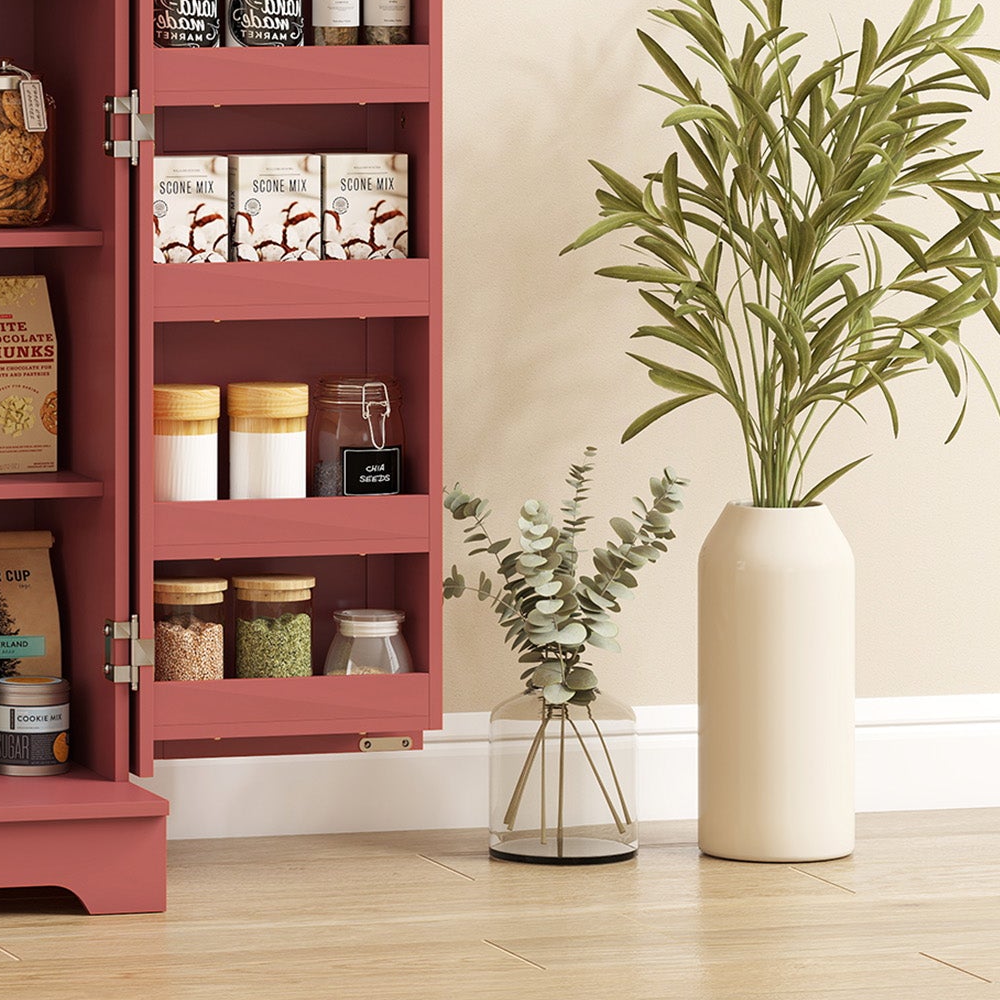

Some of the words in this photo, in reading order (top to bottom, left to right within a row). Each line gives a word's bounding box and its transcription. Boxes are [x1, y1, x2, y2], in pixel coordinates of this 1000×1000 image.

[159, 180, 192, 195] SCONE
[196, 180, 214, 194] MIX
[252, 179, 285, 193] SCONE
[288, 179, 307, 193] MIX
[340, 178, 373, 192] SCONE
[376, 177, 395, 191] MIX
[365, 464, 385, 473] CHIA
[359, 474, 391, 483] SEEDS
[6, 570, 31, 582] CUP
[17, 715, 49, 723] COOKIE
